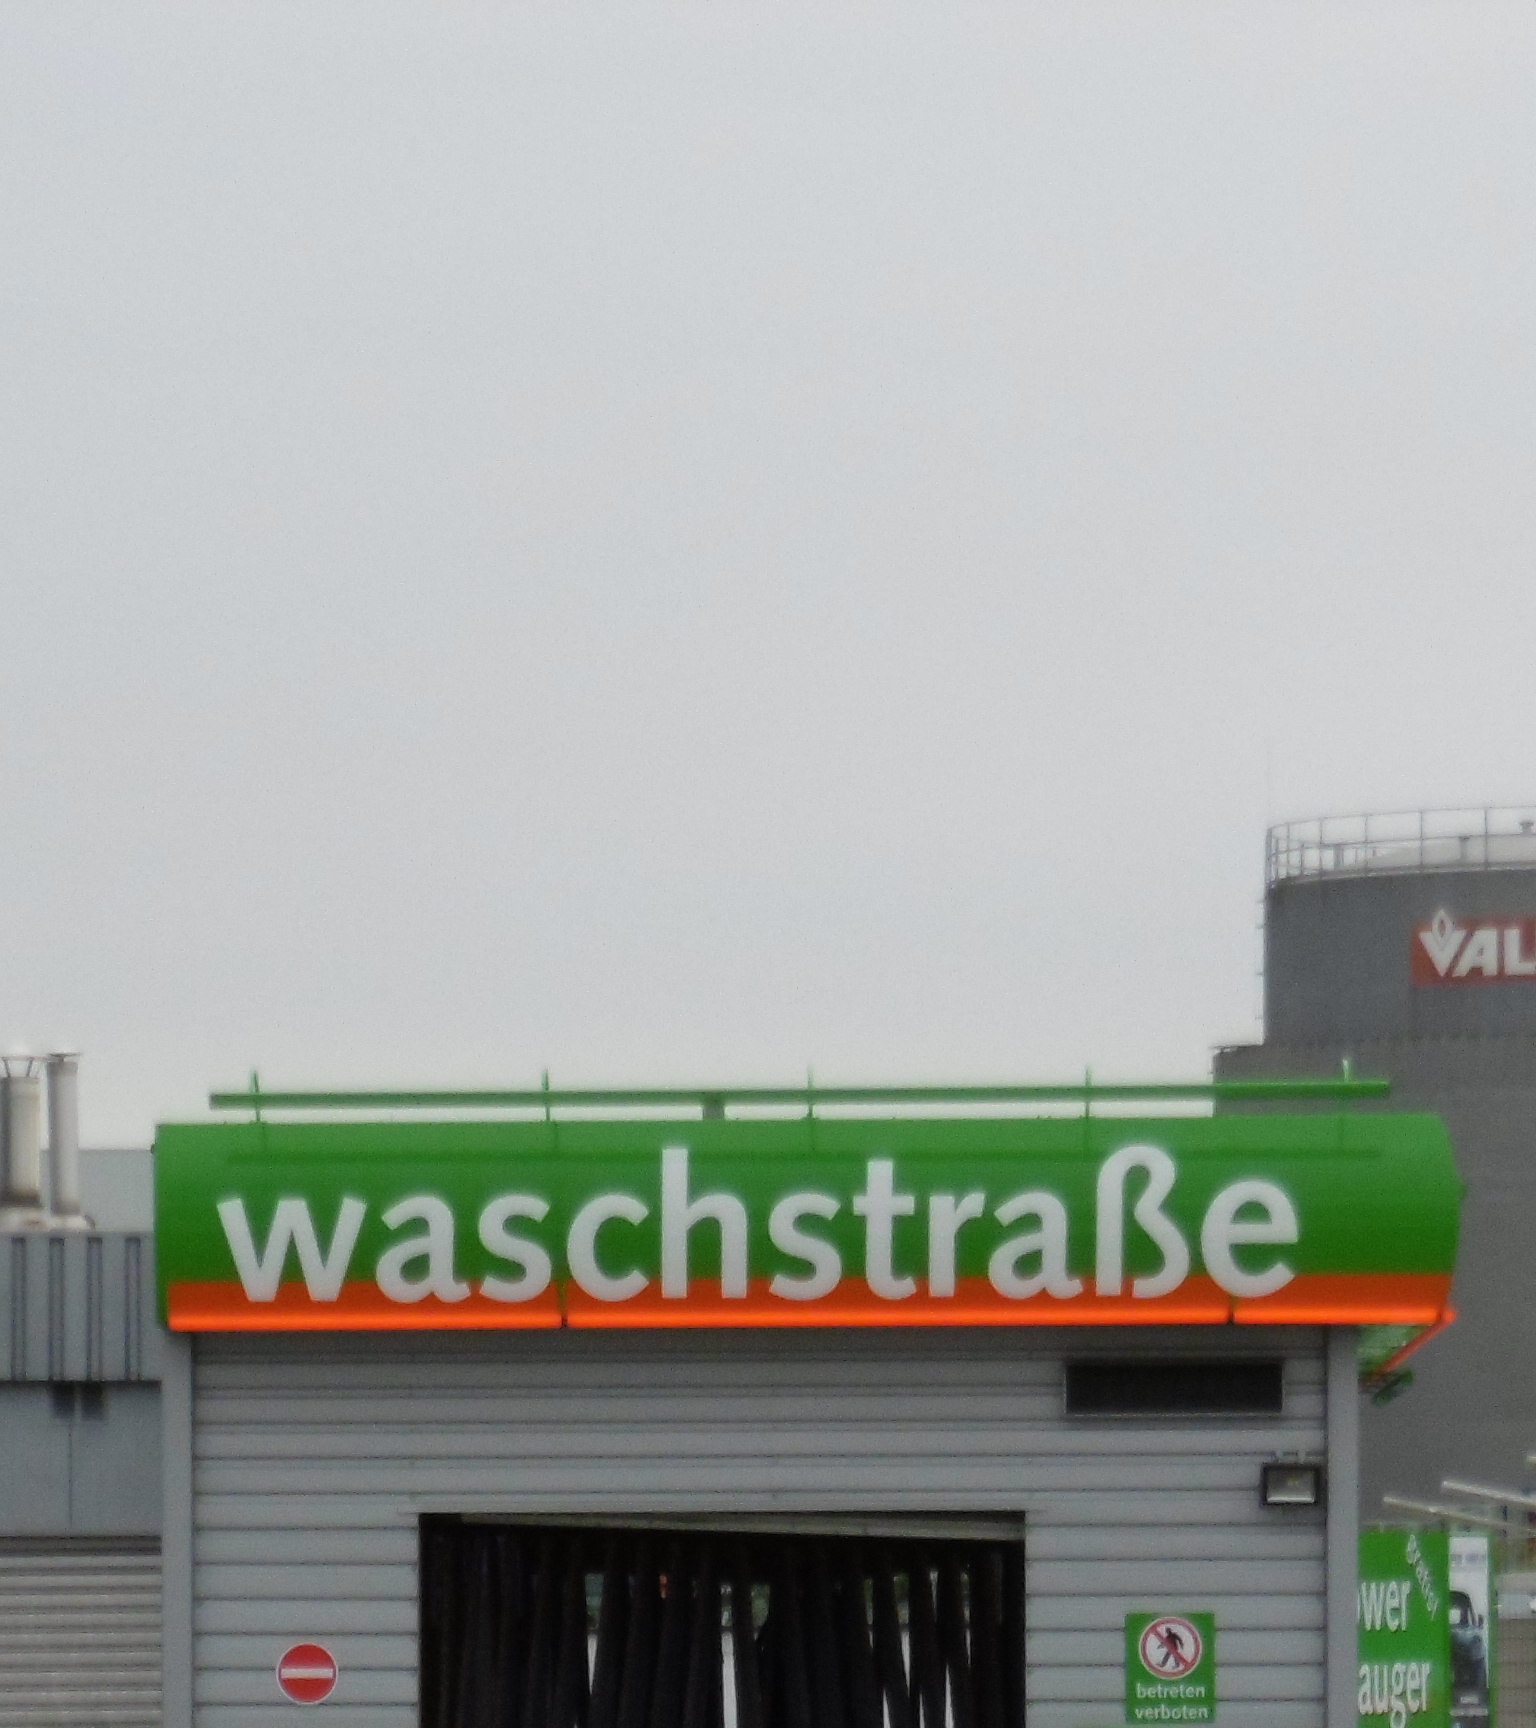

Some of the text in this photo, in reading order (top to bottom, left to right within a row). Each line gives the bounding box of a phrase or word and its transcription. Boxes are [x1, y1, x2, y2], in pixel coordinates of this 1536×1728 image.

[216, 1144, 1299, 1304] waschstraße
[1358, 1580, 1411, 1632] wer
[1135, 1682, 1206, 1699] betreten
[1134, 1703, 1209, 1720] verboten
